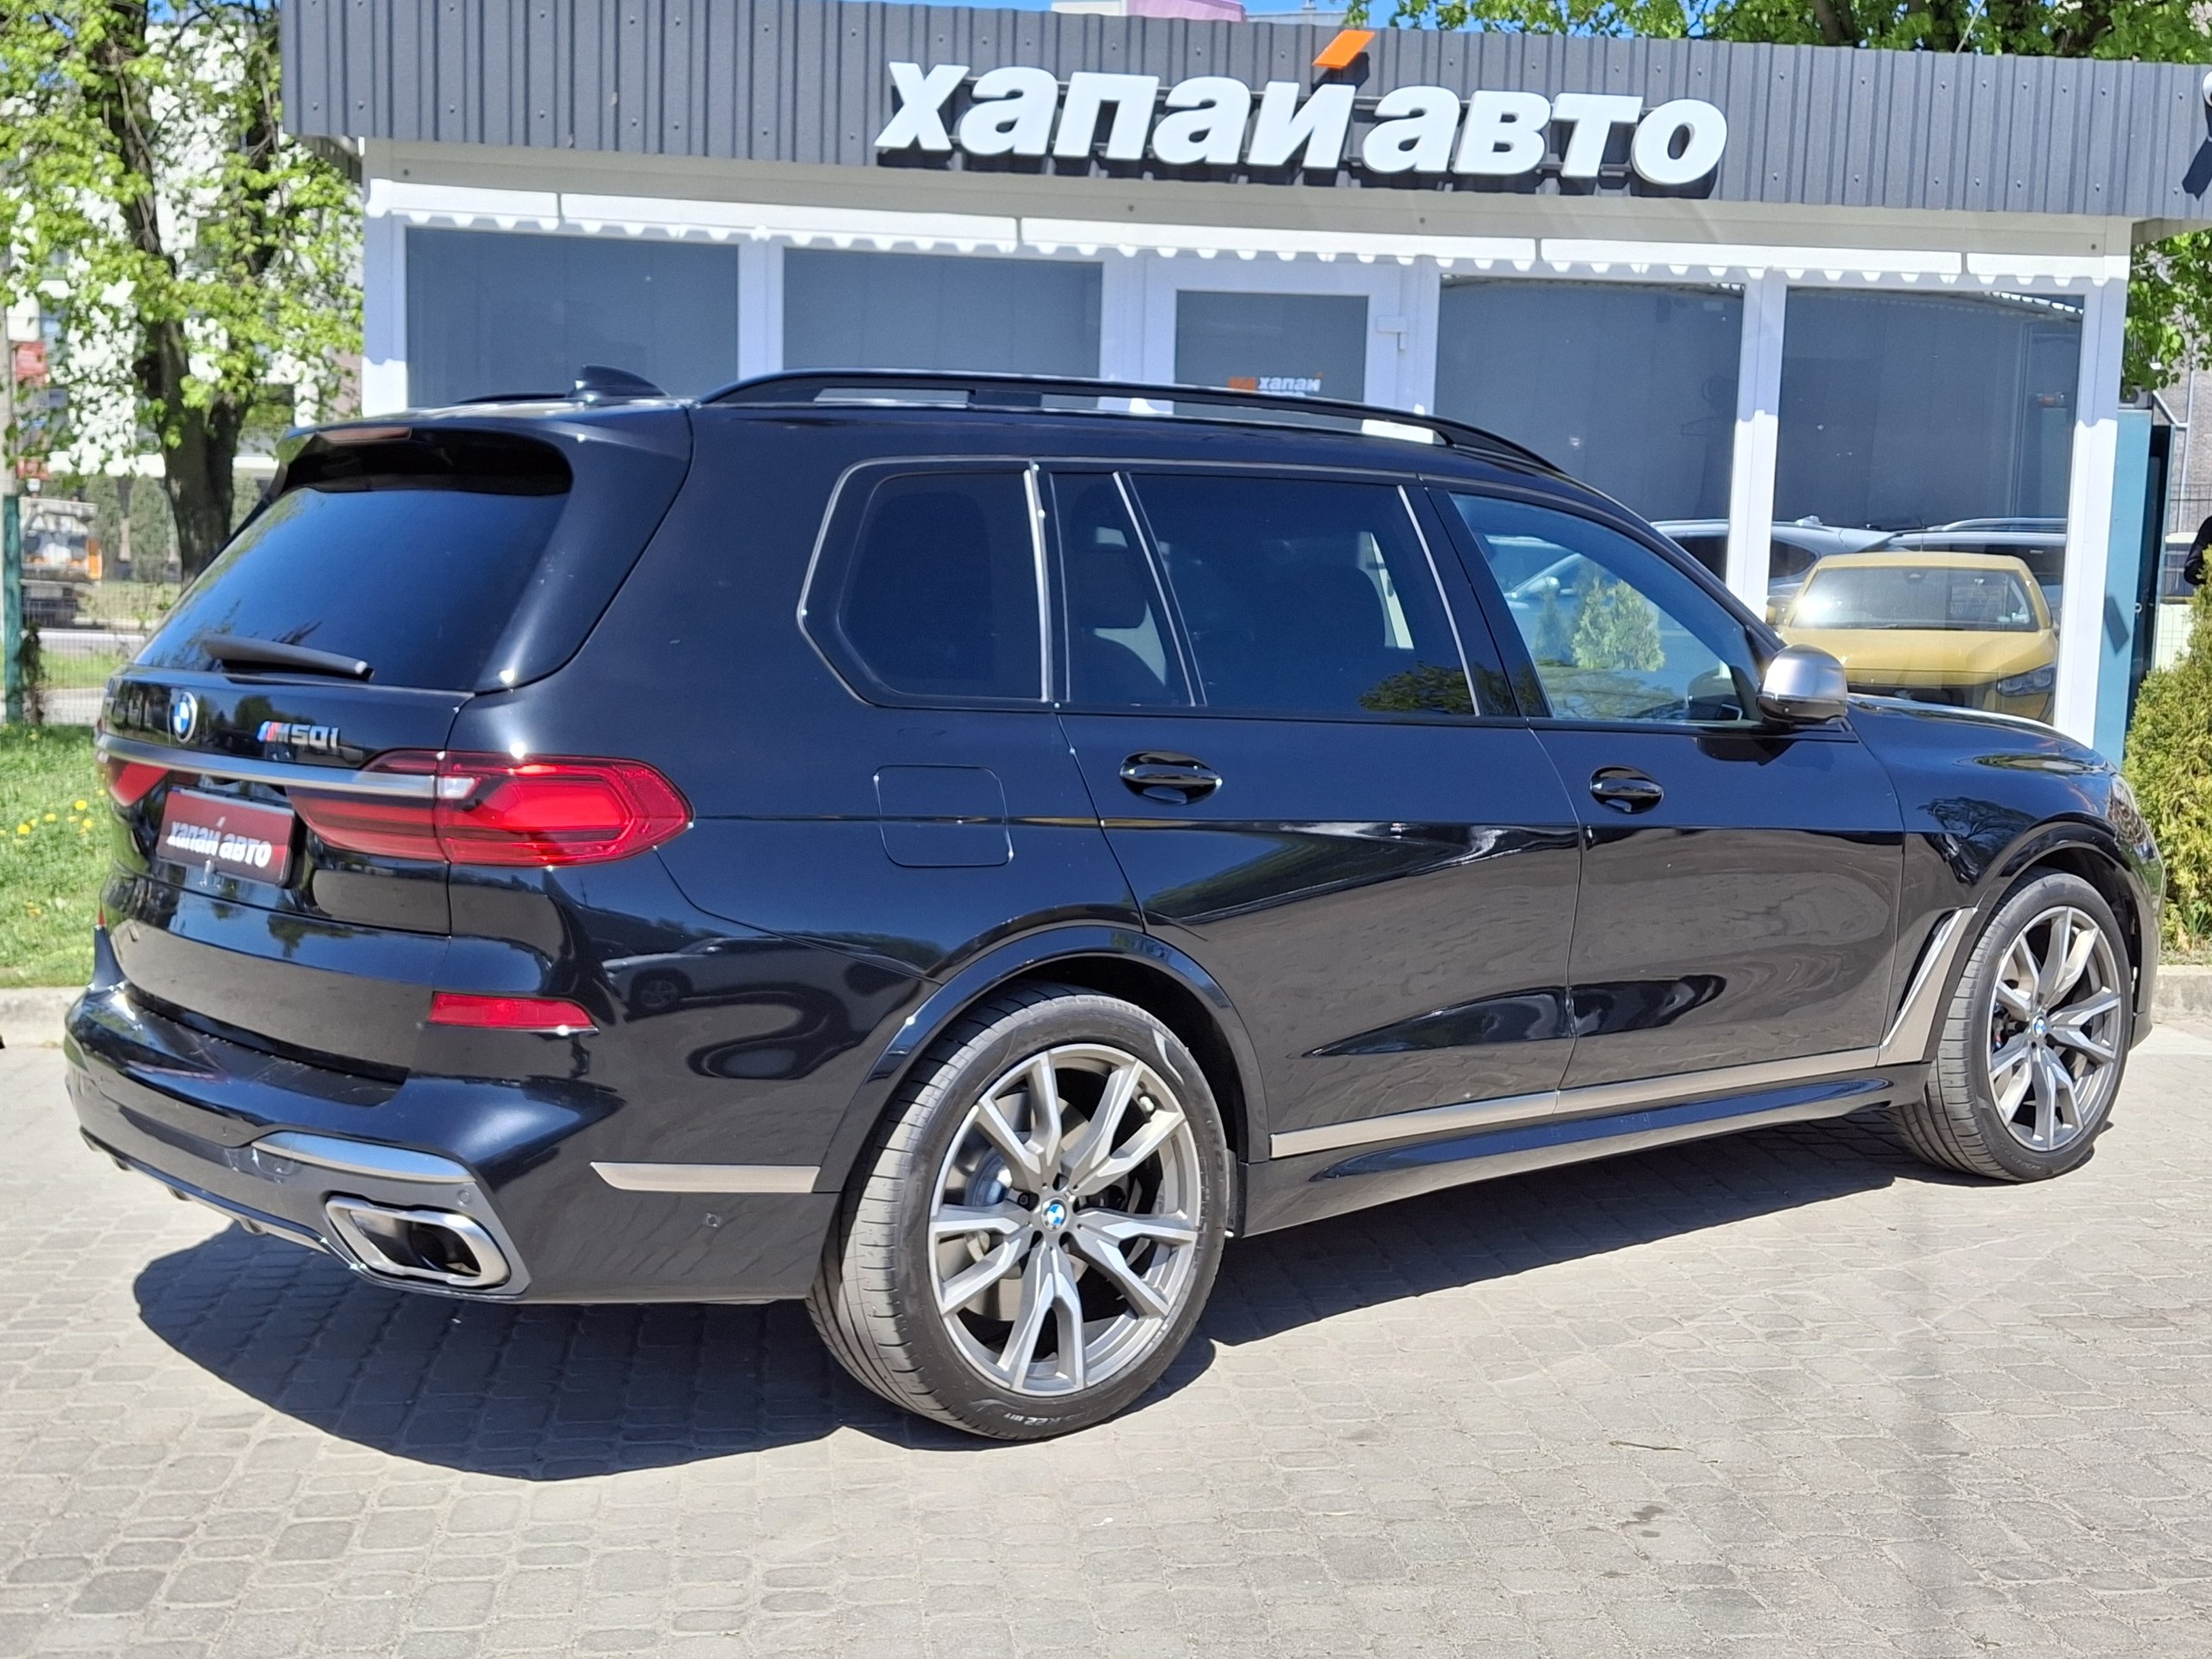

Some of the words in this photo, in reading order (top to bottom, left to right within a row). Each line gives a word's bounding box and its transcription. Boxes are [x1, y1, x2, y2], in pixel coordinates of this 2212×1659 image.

[874, 29, 1376, 168] хапай
[1362, 86, 1727, 186] авто
[219, 833, 272, 868] авто
